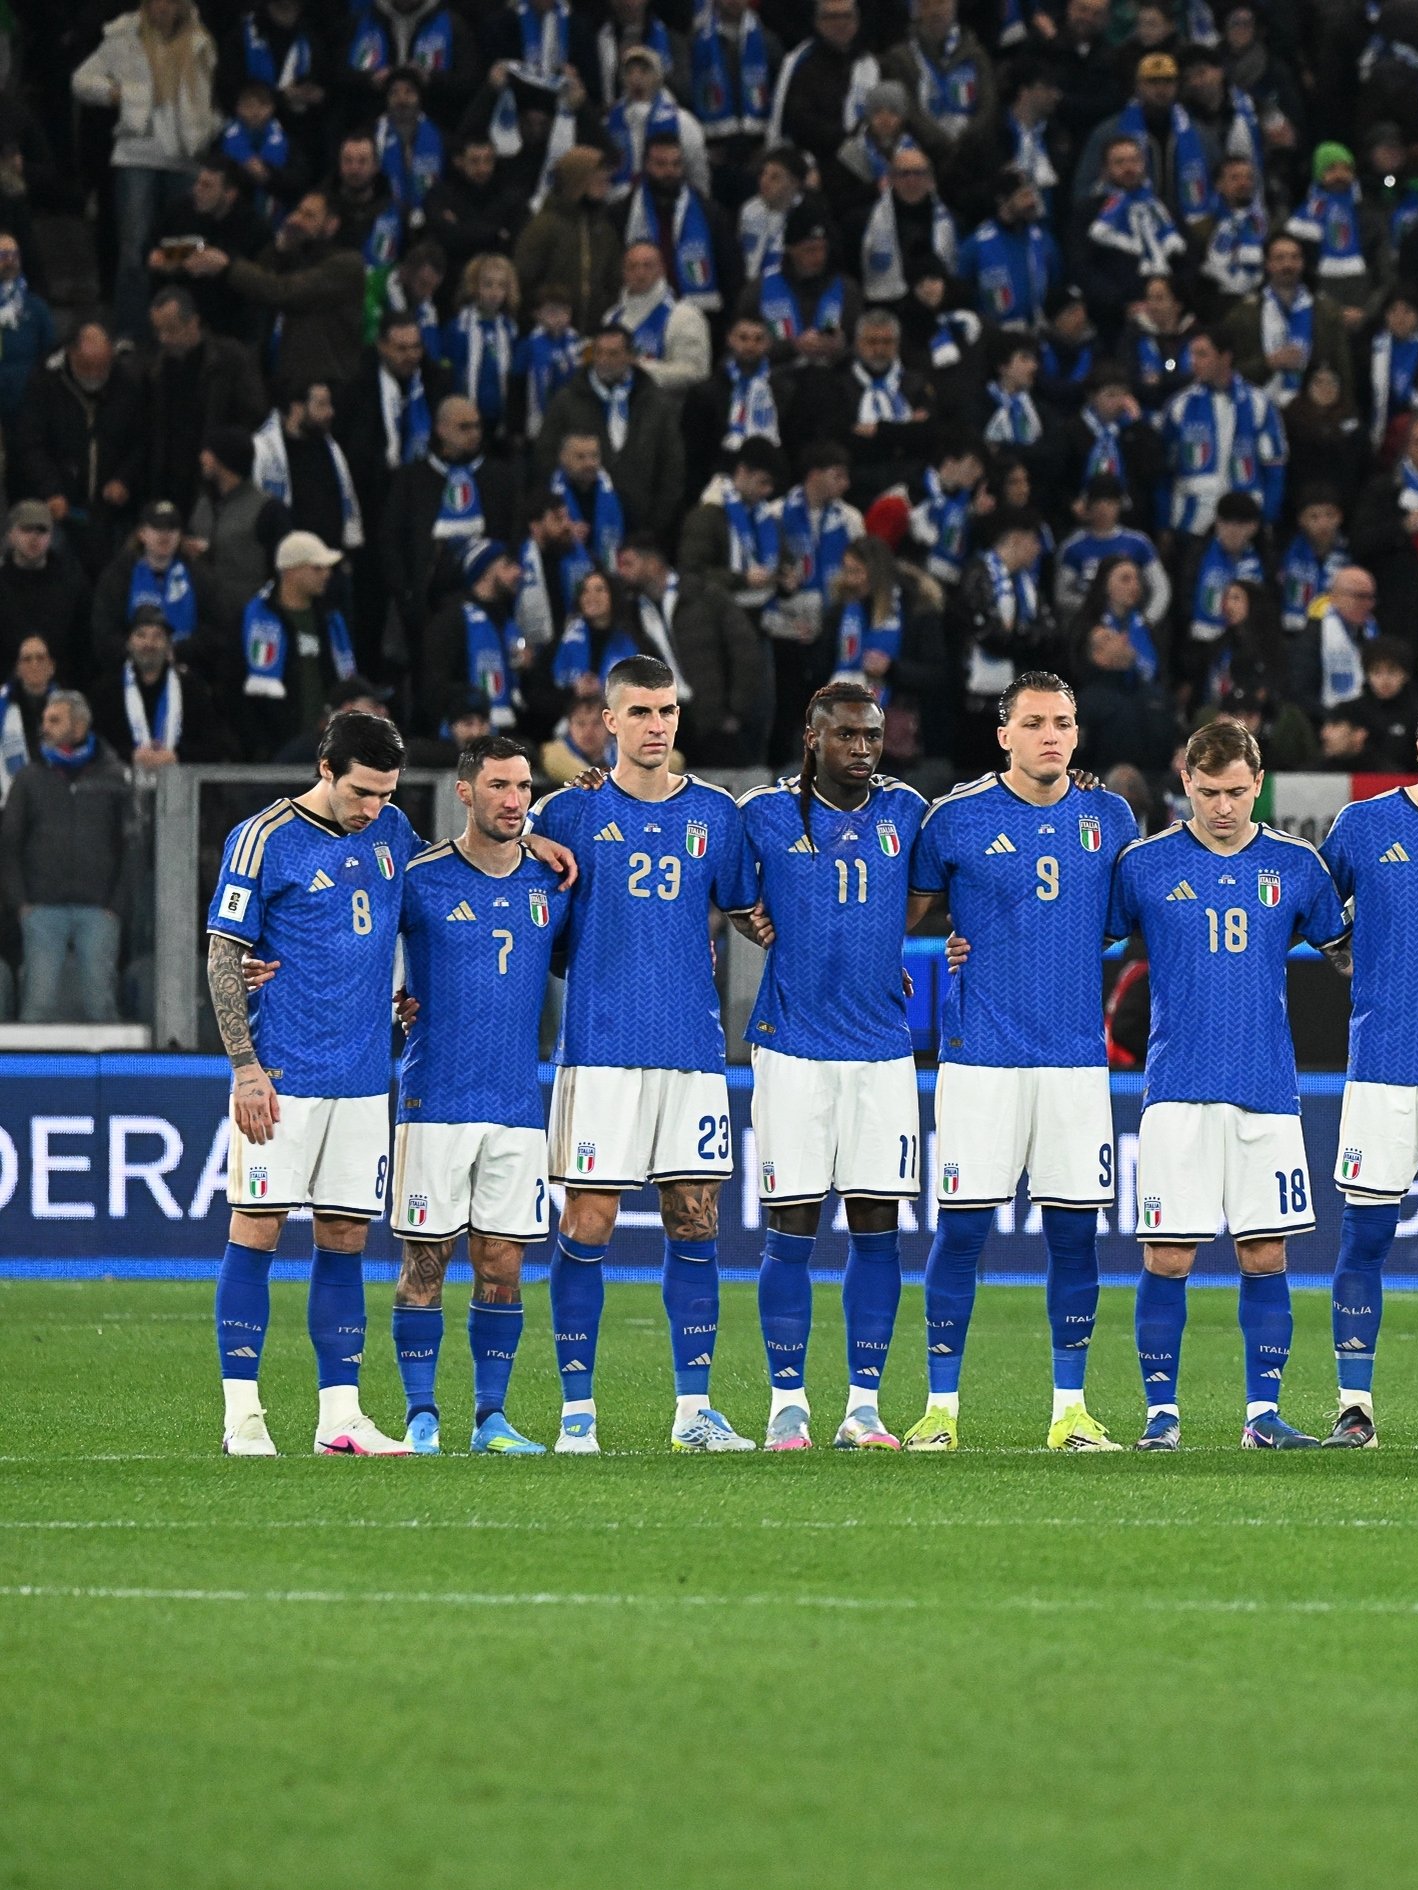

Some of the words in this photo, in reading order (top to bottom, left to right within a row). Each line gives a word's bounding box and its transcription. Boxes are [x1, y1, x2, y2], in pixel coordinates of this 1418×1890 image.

[688, 826, 706, 837] ITALIA
[628, 852, 681, 900] 23
[835, 858, 868, 904] 11
[1036, 856, 1060, 901] 9
[1260, 875, 1279, 885] ITALIA
[352, 889, 372, 935] 8
[1205, 907, 1248, 953] 18
[492, 929, 514, 975] 7
[697, 1114, 729, 1160] 23
[375, 1155, 388, 1200] 8
[1098, 1143, 1112, 1188] 9
[1275, 1168, 1307, 1215] 18
[222, 1319, 262, 1332] ITALIA
[683, 1323, 717, 1335] ITALIA
[1333, 1300, 1372, 1315] ITALIA
[401, 1349, 434, 1359] ITALIA
[768, 1340, 804, 1352] ITALIA
